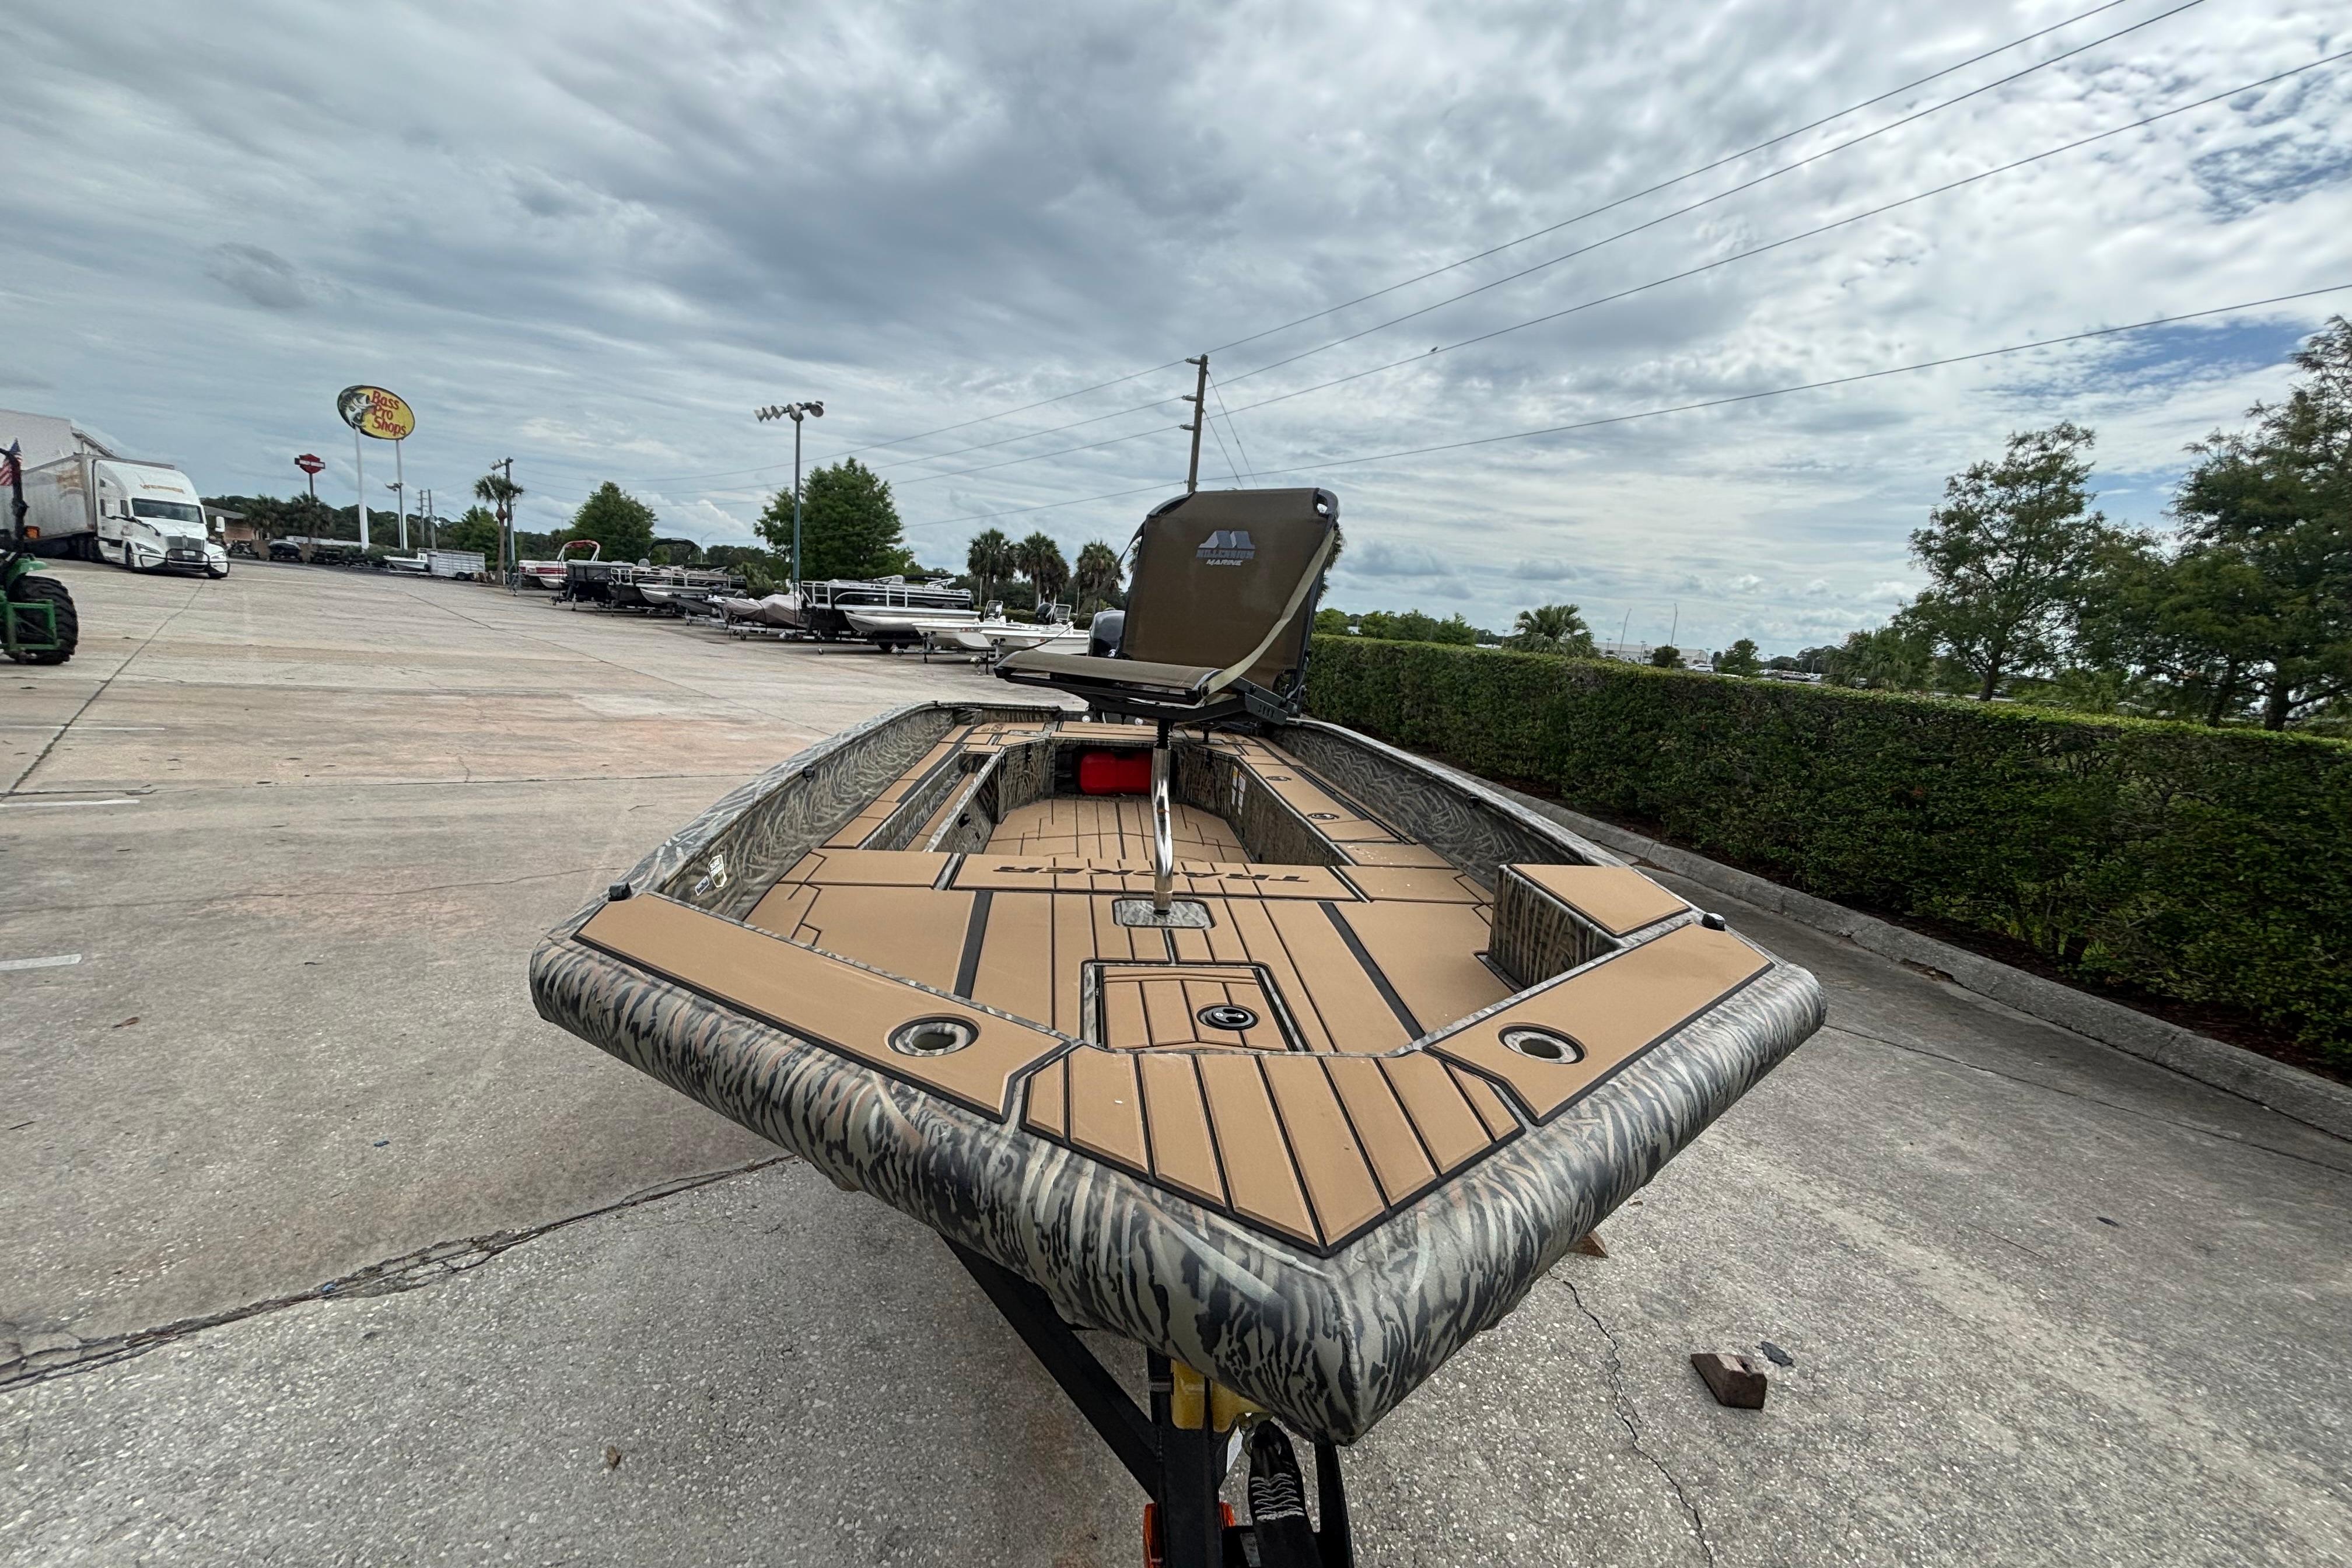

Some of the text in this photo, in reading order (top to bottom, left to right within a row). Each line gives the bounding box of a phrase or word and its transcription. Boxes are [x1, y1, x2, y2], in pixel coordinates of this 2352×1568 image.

[372, 390, 399, 410] Bass
[373, 404, 393, 420] Pro
[372, 416, 407, 436] Shops
[992, 866, 1310, 882] TRACKER
